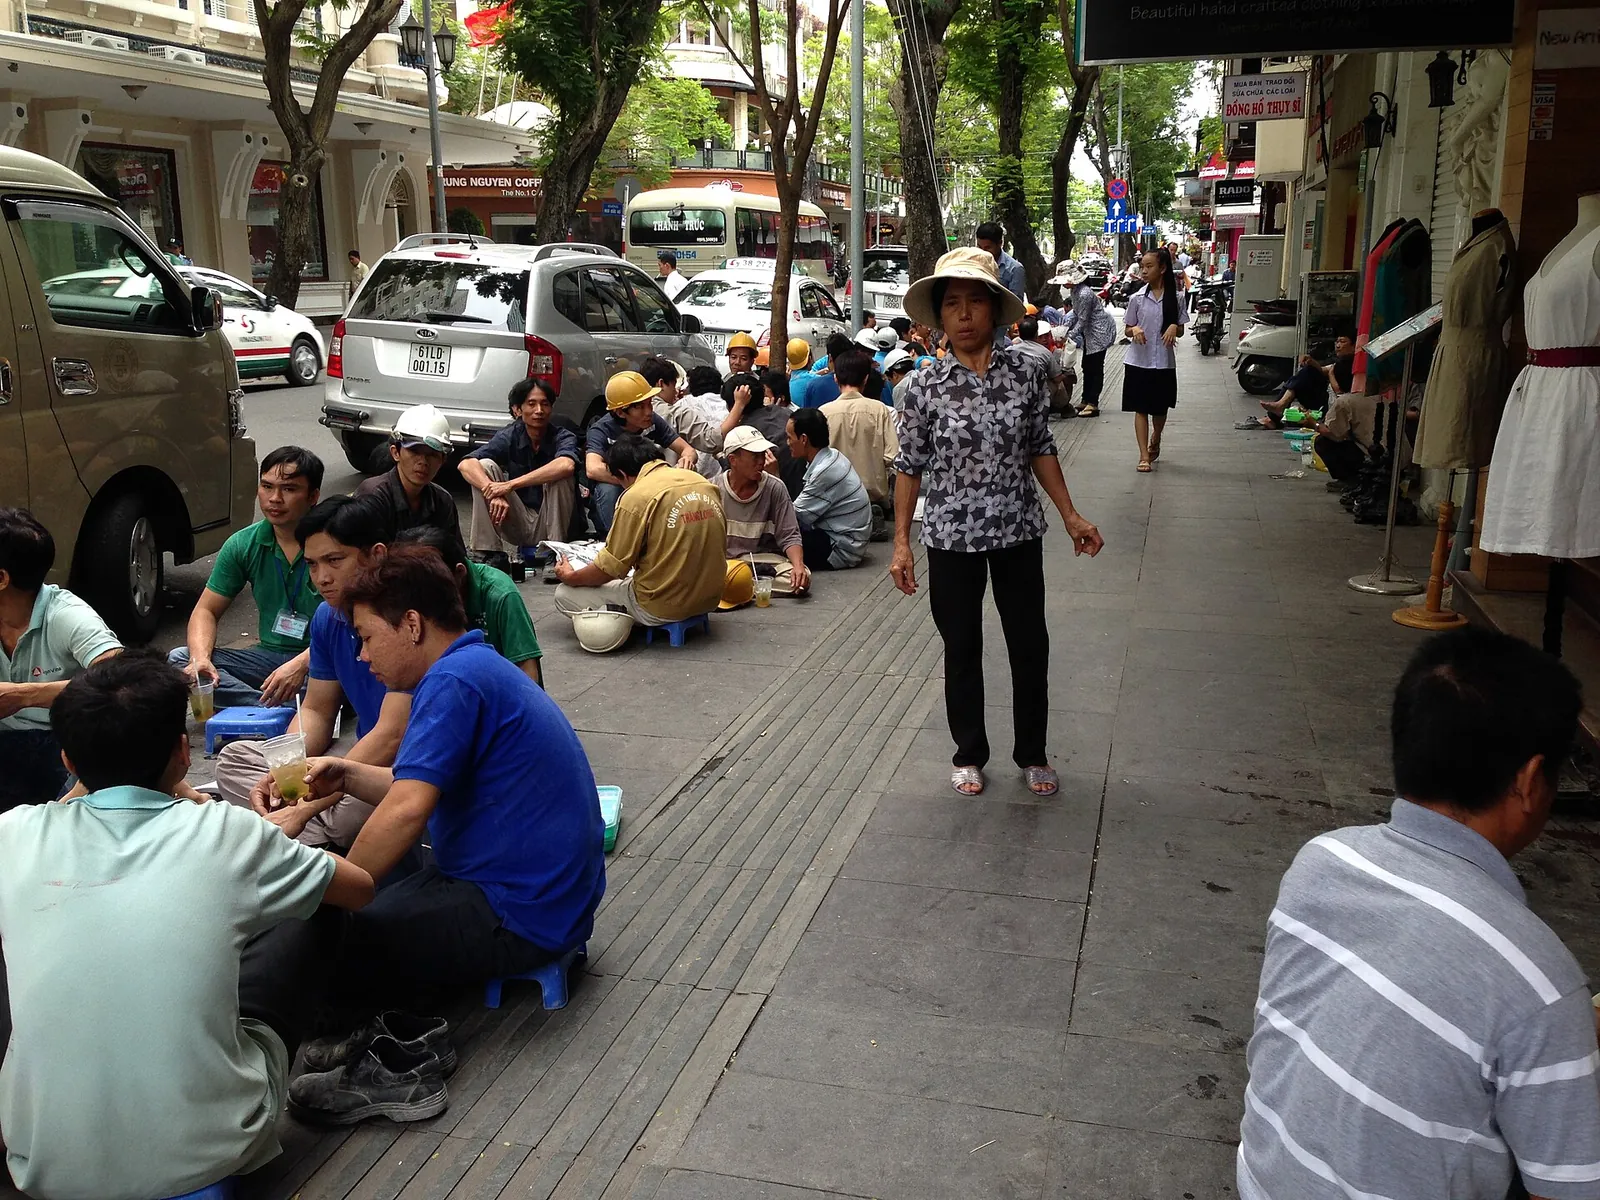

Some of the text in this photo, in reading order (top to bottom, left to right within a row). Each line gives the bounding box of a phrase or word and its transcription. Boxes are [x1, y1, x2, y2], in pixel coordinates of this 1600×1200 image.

[1130, 4, 1195, 20] Beautiful
[1200, 0, 1236, 16] hand
[1539, 31, 1570, 45] New
[1534, 96, 1554, 104] VISA
[442, 177, 543, 187] RUNG NGUYEN COFF
[1219, 186, 1250, 195] RADO
[653, 217, 705, 231] THANH TRÚC
[418, 345, 443, 359] 61LD
[413, 359, 445, 374] 001.15
[674, 497, 685, 508] TY
